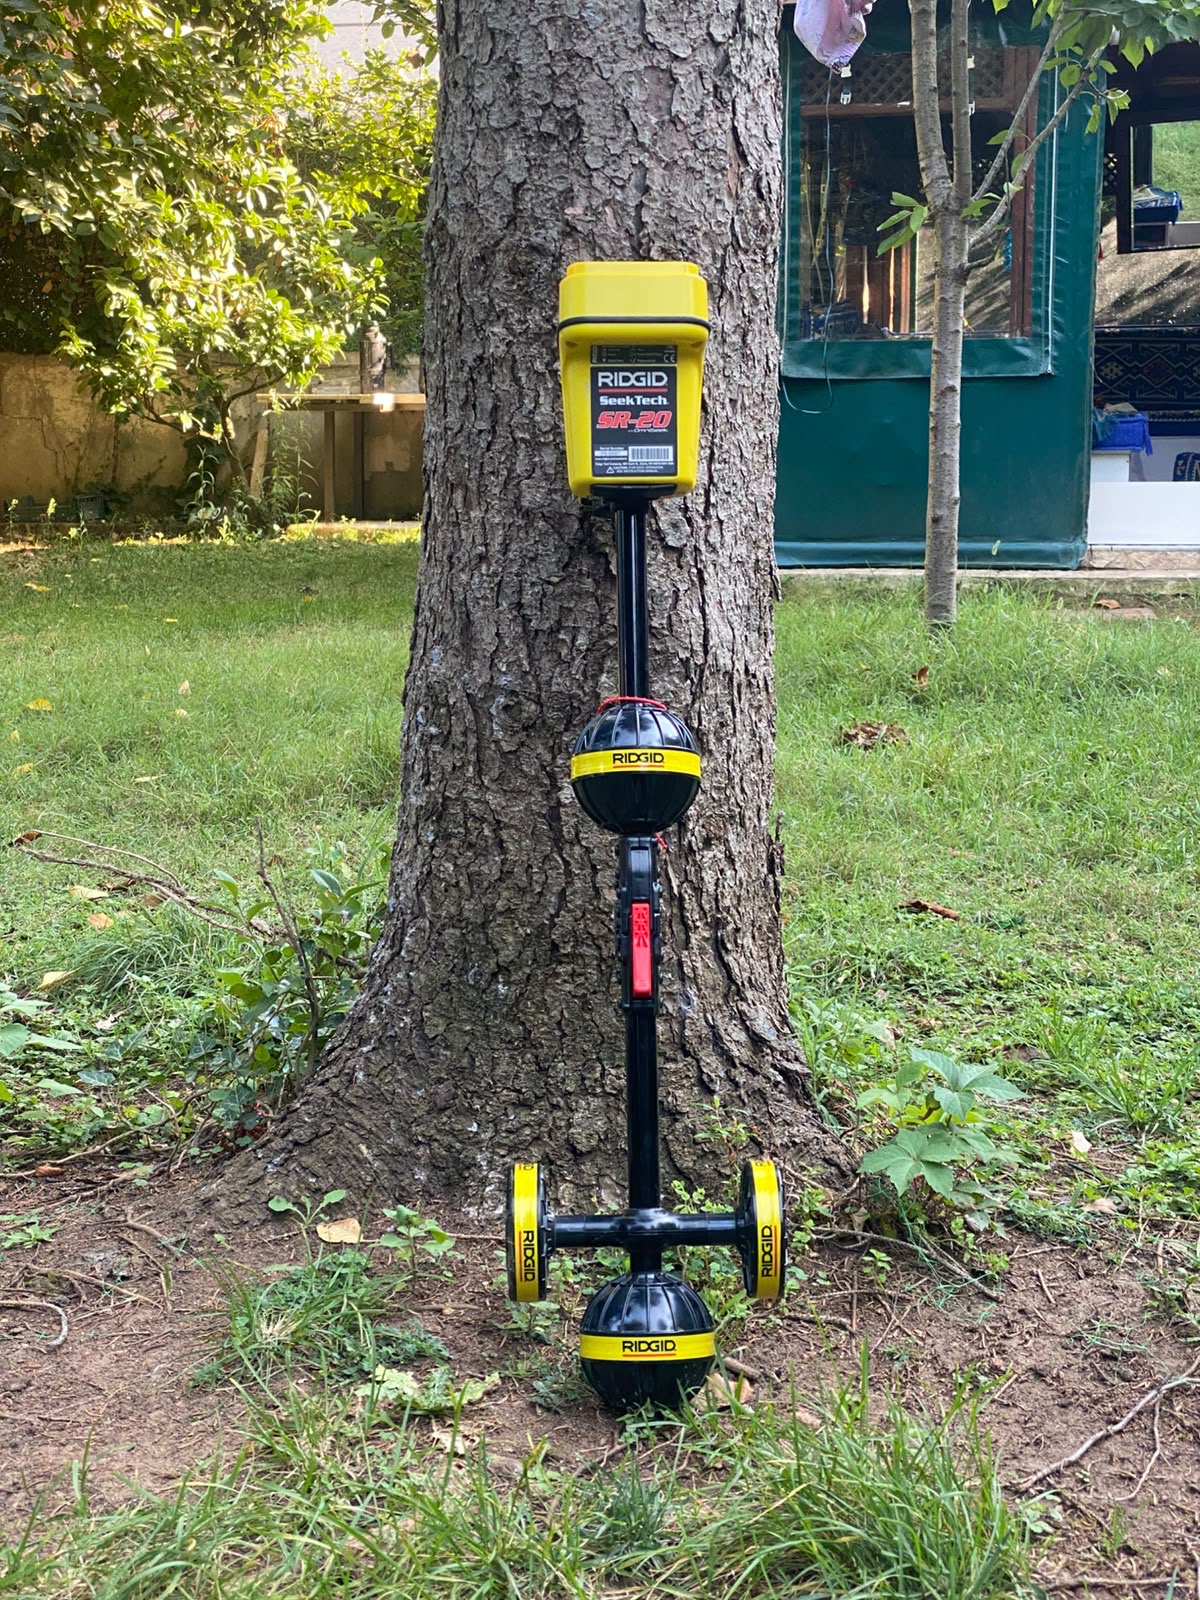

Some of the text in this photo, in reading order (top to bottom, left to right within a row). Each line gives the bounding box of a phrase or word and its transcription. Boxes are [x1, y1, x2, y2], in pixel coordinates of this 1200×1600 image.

[598, 372, 668, 386] RIDGID
[599, 396, 668, 405] SeekTech
[596, 410, 672, 429] SR-20
[613, 752, 664, 764] RIDGID
[522, 1230, 535, 1282] RIDGID
[760, 1225, 773, 1277] RIDGID
[622, 1339, 677, 1352] RIDGID
